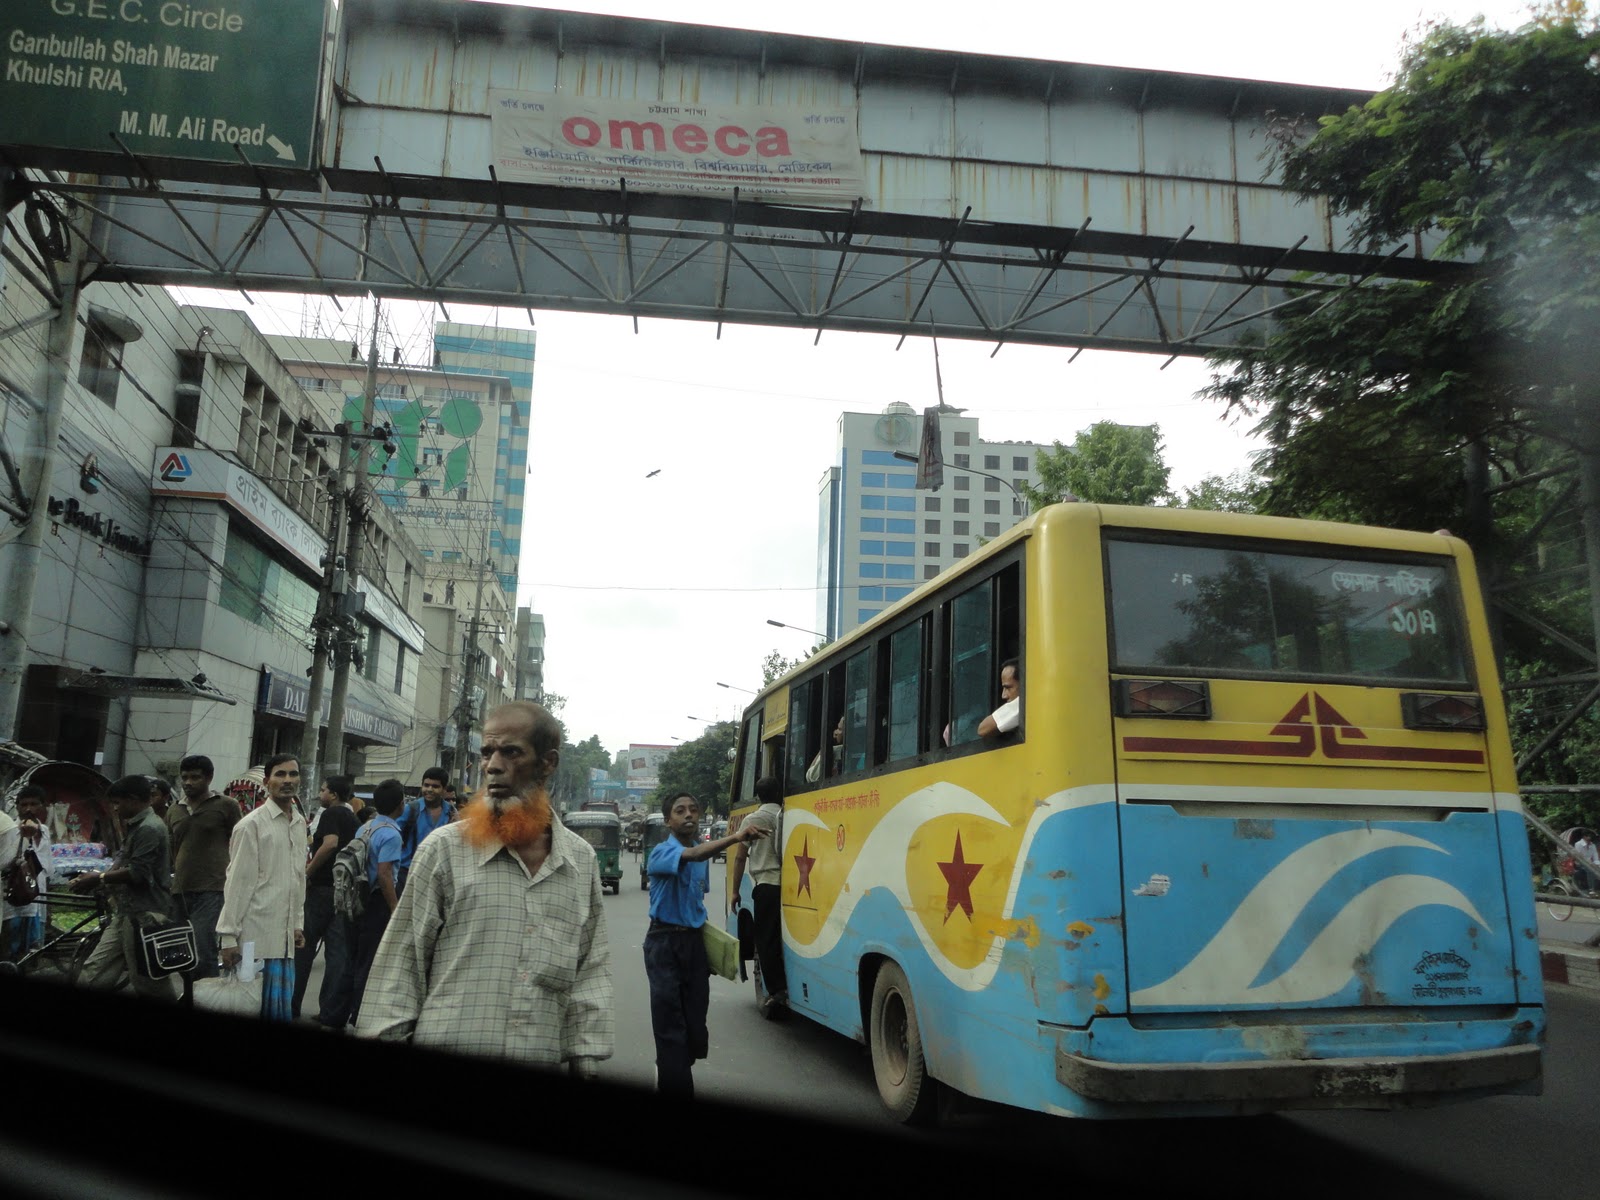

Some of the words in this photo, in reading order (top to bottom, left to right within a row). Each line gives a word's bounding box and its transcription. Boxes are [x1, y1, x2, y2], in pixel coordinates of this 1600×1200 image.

[159, 3, 243, 32] Circle
[9, 29, 105, 62] Garibullah
[112, 40, 158, 67] Shah
[163, 45, 219, 72] Mazar
[6, 59, 83, 87] Khulshi
[88, 67, 128, 96] R/A,
[119, 110, 142, 135] M.
[149, 113, 171, 138] M.
[177, 115, 205, 141] Ali
[211, 119, 265, 146] Road
[562, 116, 792, 157] omeca
[236, 475, 268, 517] প্রাইম
[271, 503, 299, 541] ব্যাংক
